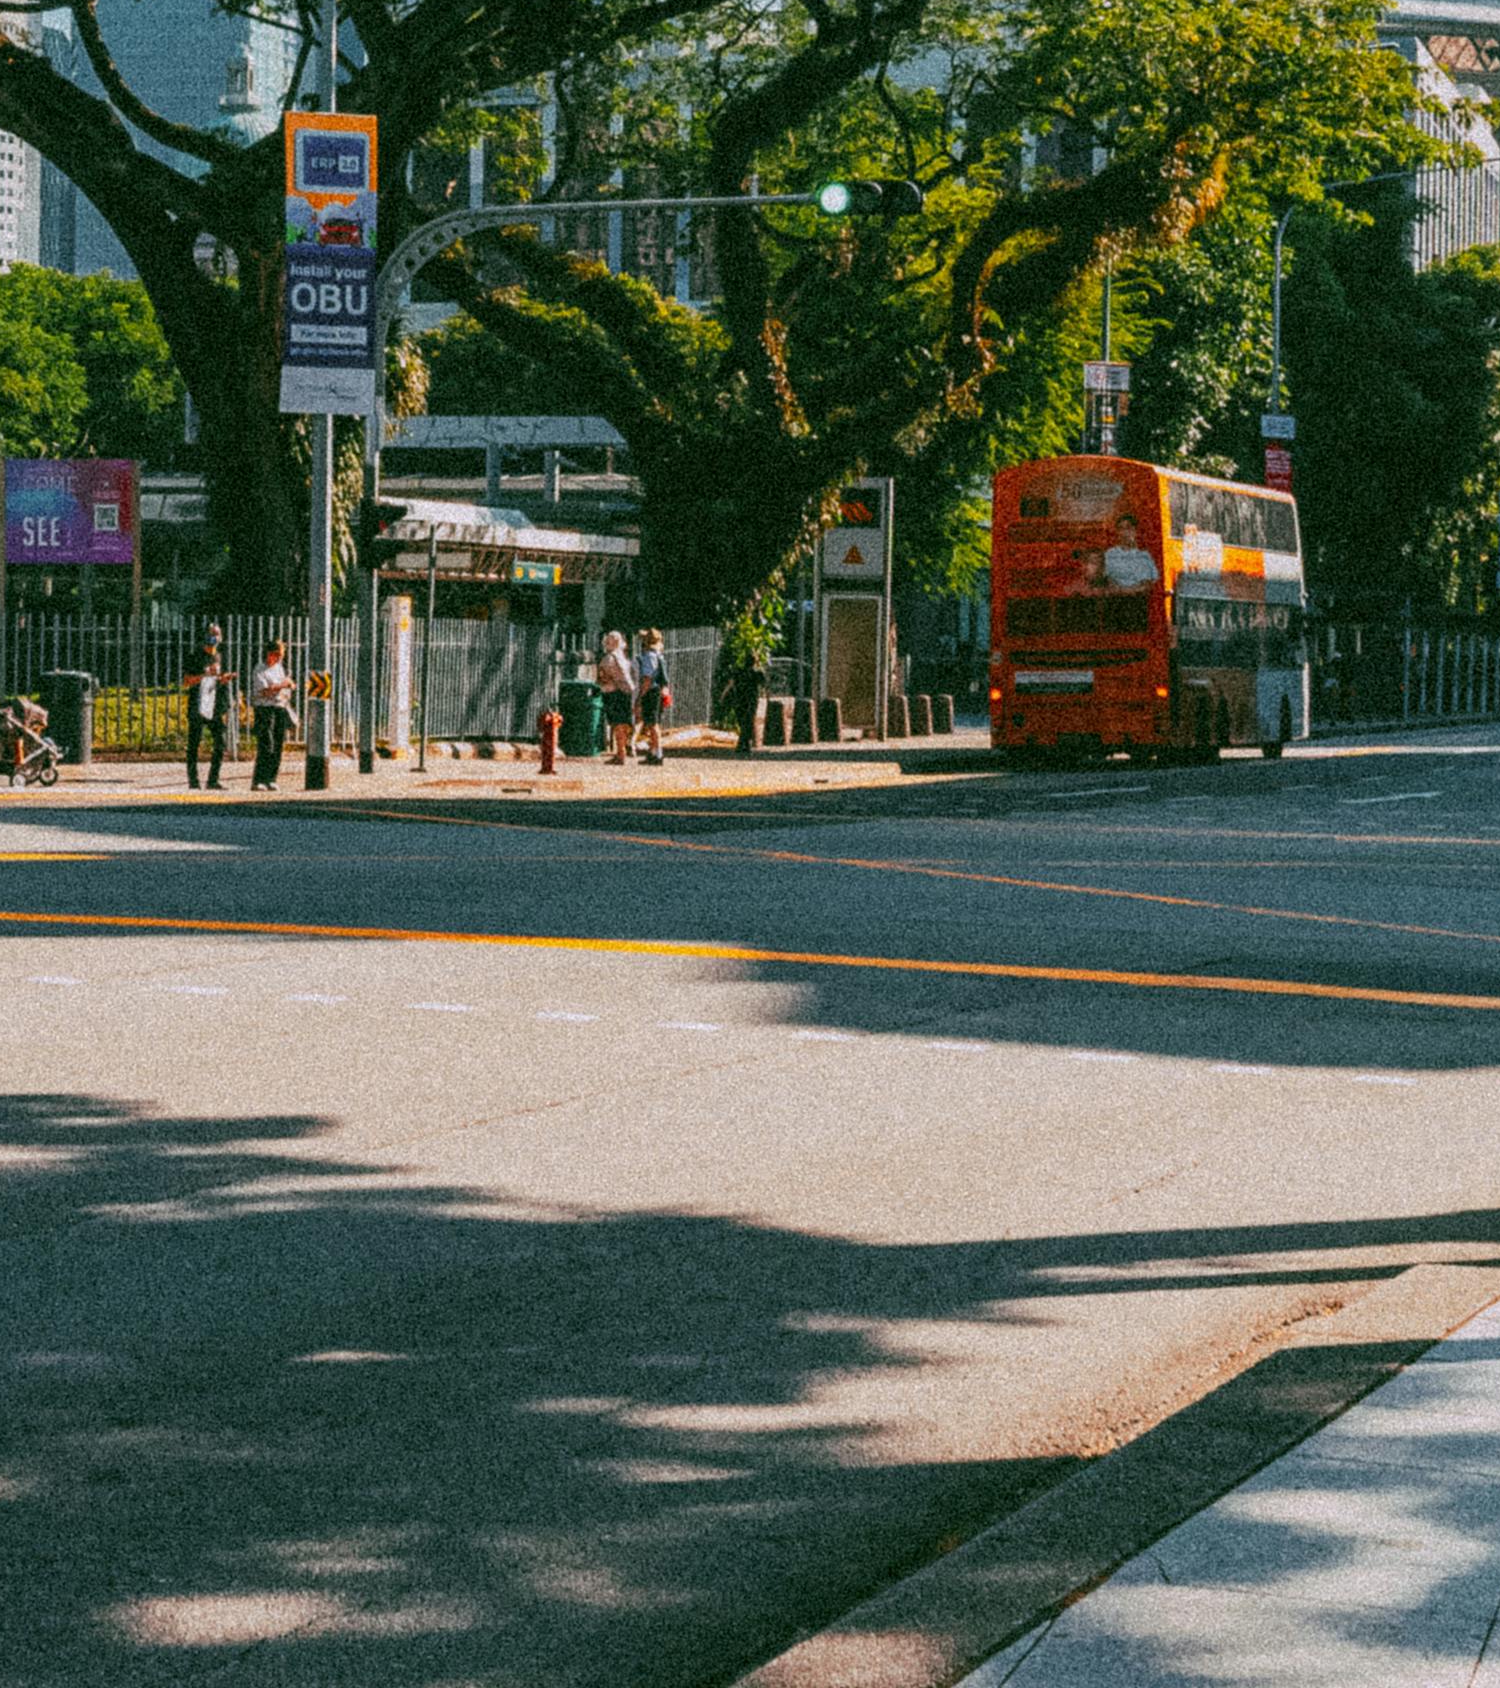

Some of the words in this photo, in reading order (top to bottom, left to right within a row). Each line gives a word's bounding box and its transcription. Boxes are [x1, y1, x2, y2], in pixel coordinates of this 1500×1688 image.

[310, 156, 337, 170] ERP
[290, 263, 331, 278] Install
[335, 267, 368, 281] your
[290, 281, 368, 315] OBU
[22, 515, 61, 547] SEE
